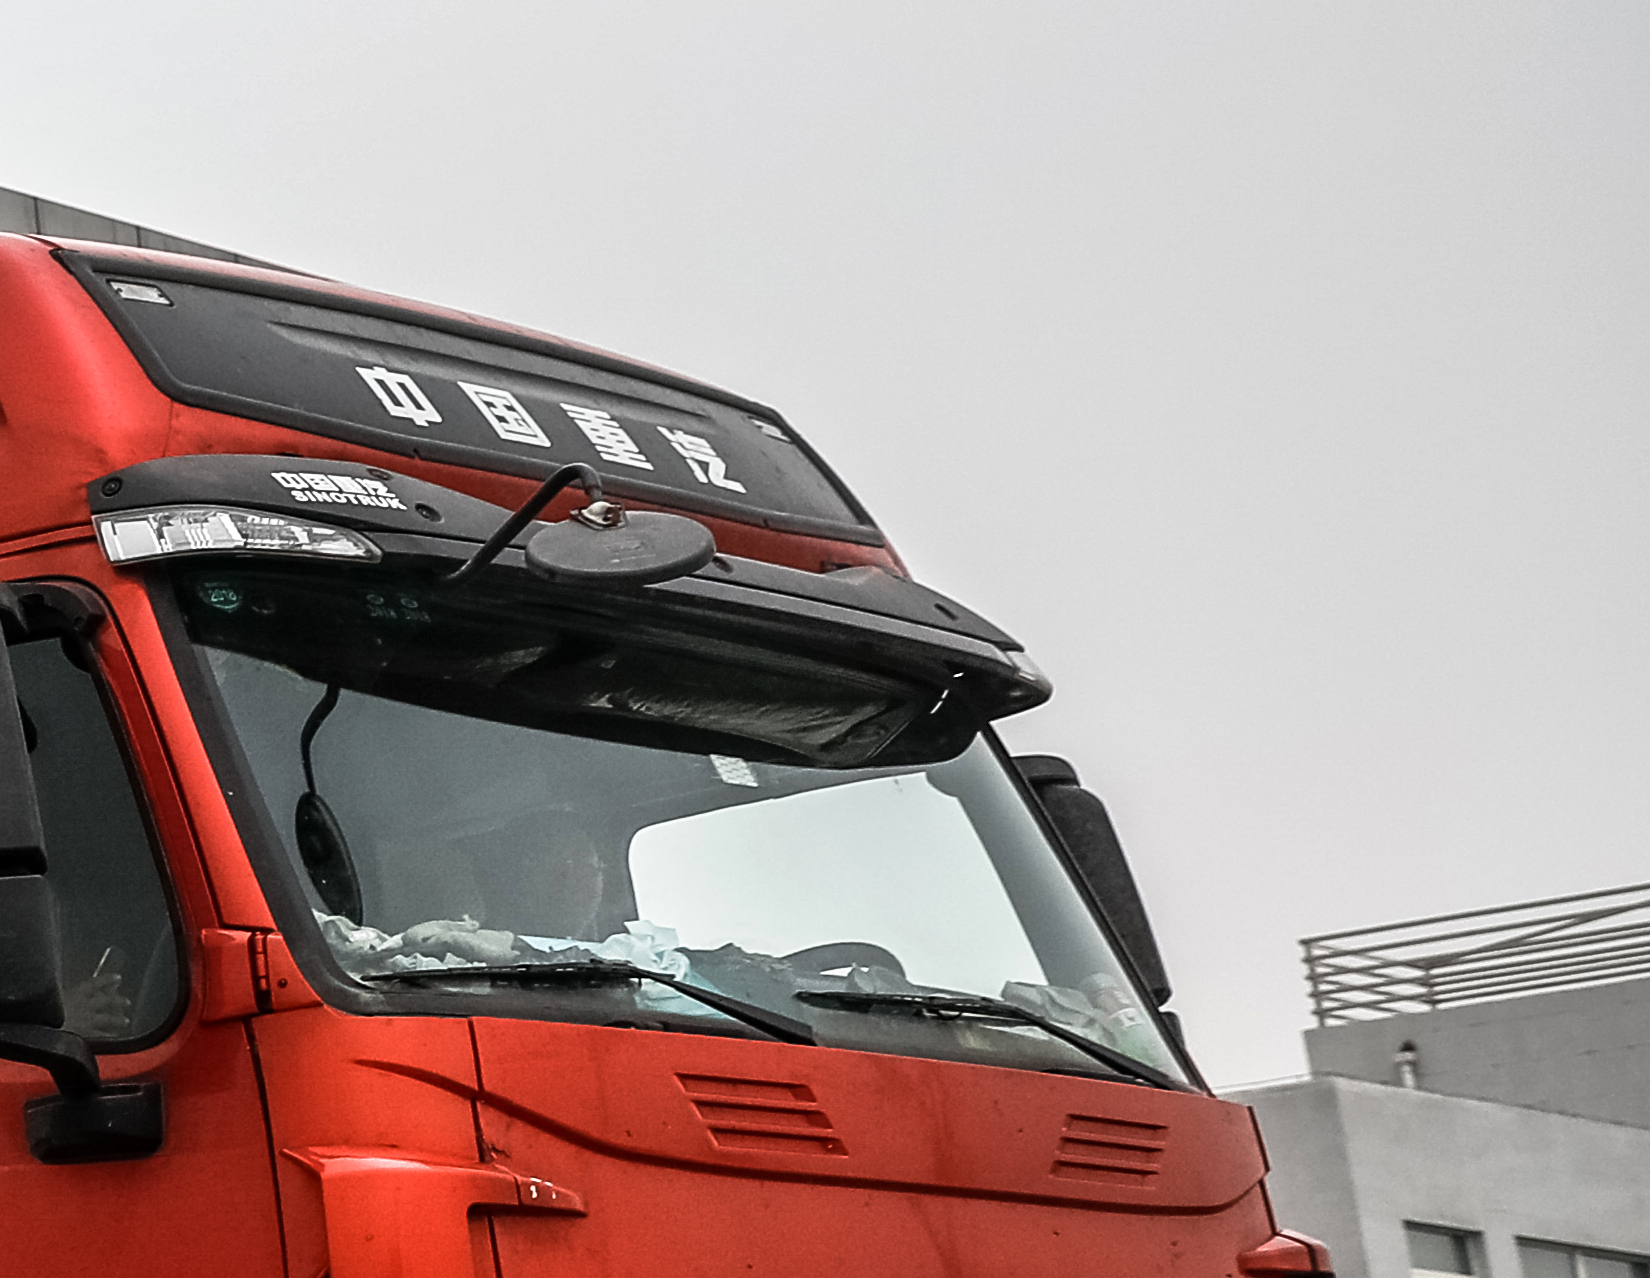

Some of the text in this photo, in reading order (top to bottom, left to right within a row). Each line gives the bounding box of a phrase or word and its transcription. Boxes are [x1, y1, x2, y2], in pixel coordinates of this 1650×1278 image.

[355, 364, 746, 494] 中国重汽
[290, 490, 407, 511] SINOTRUK
